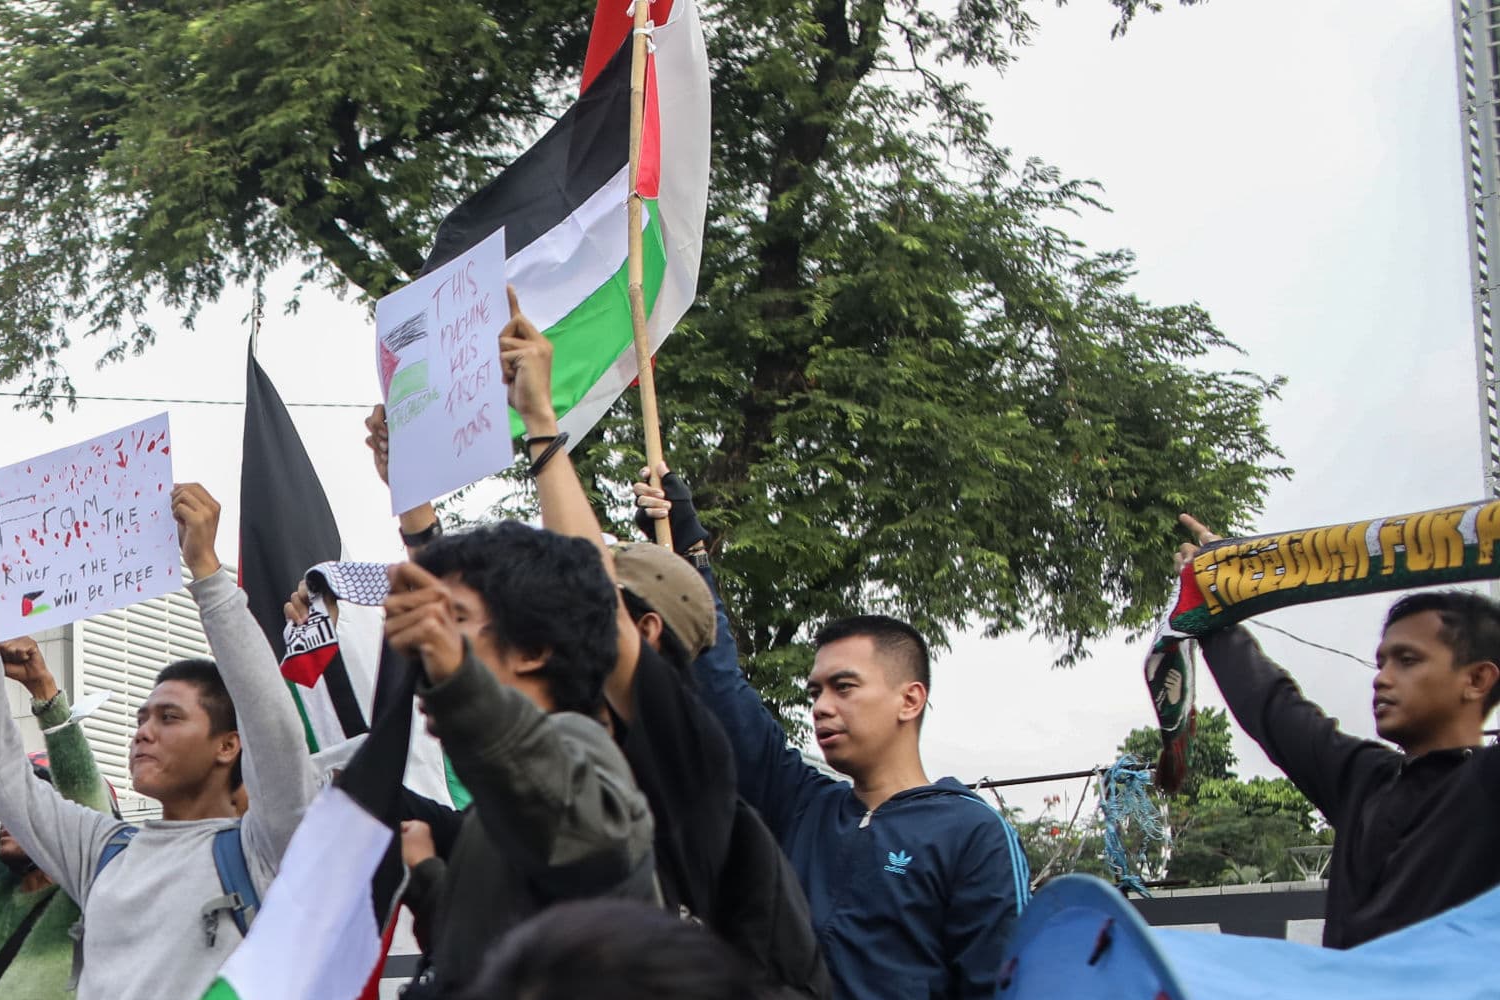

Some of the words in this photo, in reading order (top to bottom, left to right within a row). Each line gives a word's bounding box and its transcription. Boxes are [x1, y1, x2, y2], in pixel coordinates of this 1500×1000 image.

[102, 508, 139, 534] THE
[80, 559, 108, 577] THE
[113, 565, 154, 593] FREE
